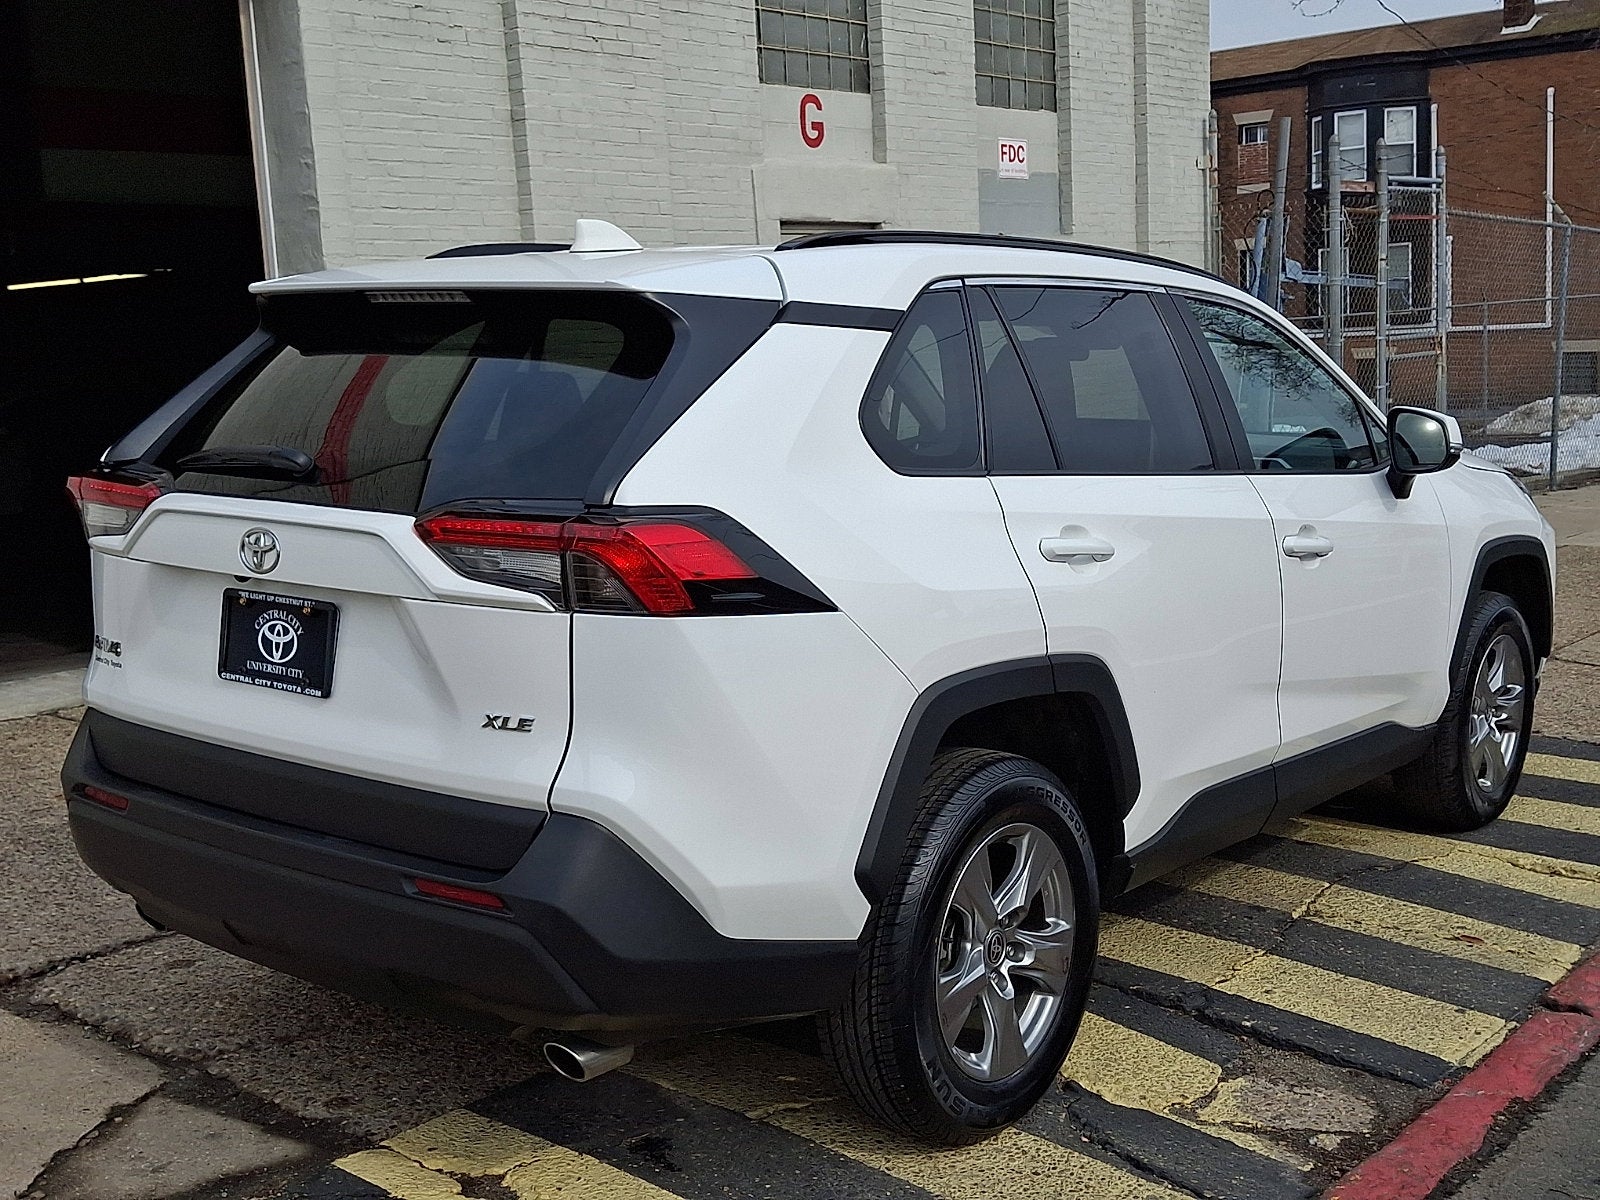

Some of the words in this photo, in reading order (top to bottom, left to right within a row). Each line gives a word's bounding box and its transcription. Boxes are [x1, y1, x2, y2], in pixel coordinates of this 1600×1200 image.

[799, 93, 825, 149] G
[1000, 143, 1026, 164] FDC
[250, 592, 266, 601] LIGHT
[275, 596, 304, 607] CHESTNUT
[254, 609, 288, 630] CENTRAL
[287, 614, 305, 635] CITY
[246, 660, 288, 676] UNIVERSITY
[287, 667, 305, 679] CITY
[221, 672, 254, 684] CENTRAL
[254, 678, 272, 687] CITY
[272, 681, 302, 694] TOYOTA
[302, 687, 322, 698] .COM
[481, 713, 537, 733] XLE
